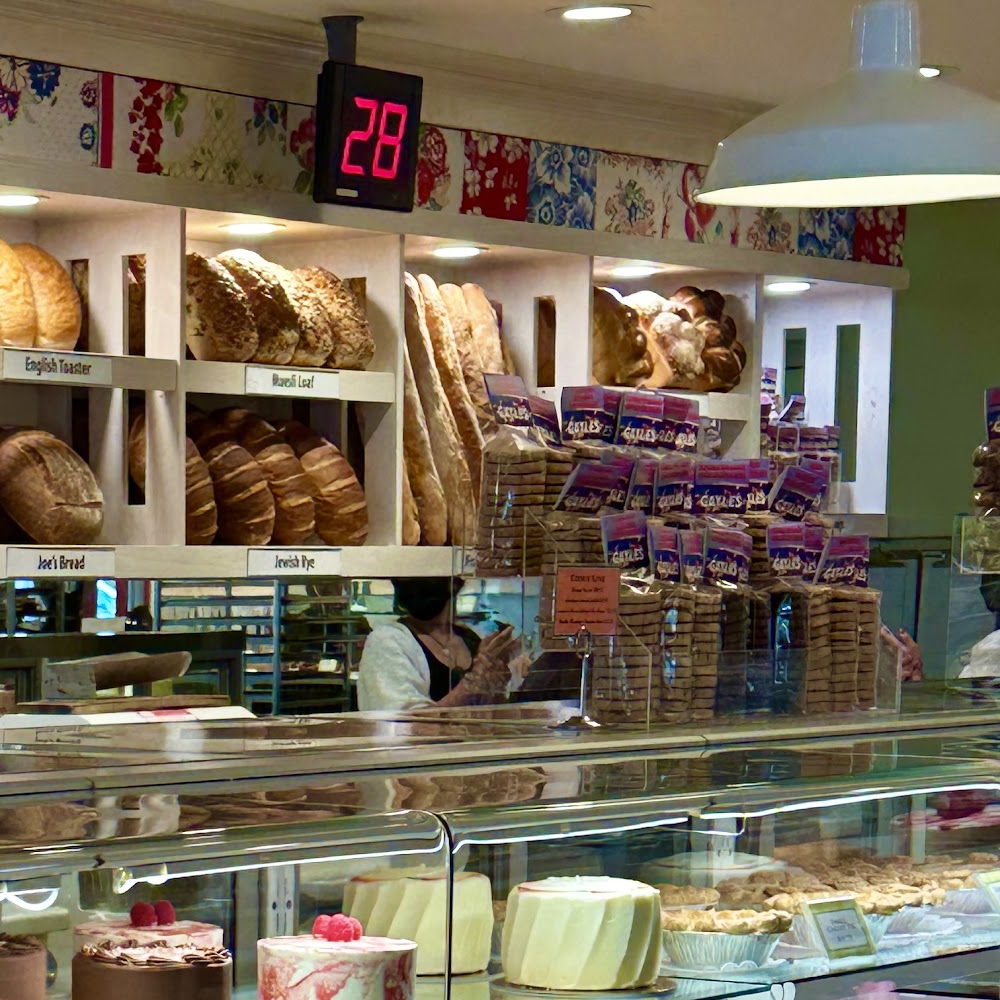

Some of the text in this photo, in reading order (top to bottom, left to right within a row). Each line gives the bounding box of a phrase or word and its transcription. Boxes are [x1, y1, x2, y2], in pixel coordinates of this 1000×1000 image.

[341, 96, 408, 180] 28
[25, 356, 57, 376] English
[59, 555, 85, 570] Bread
